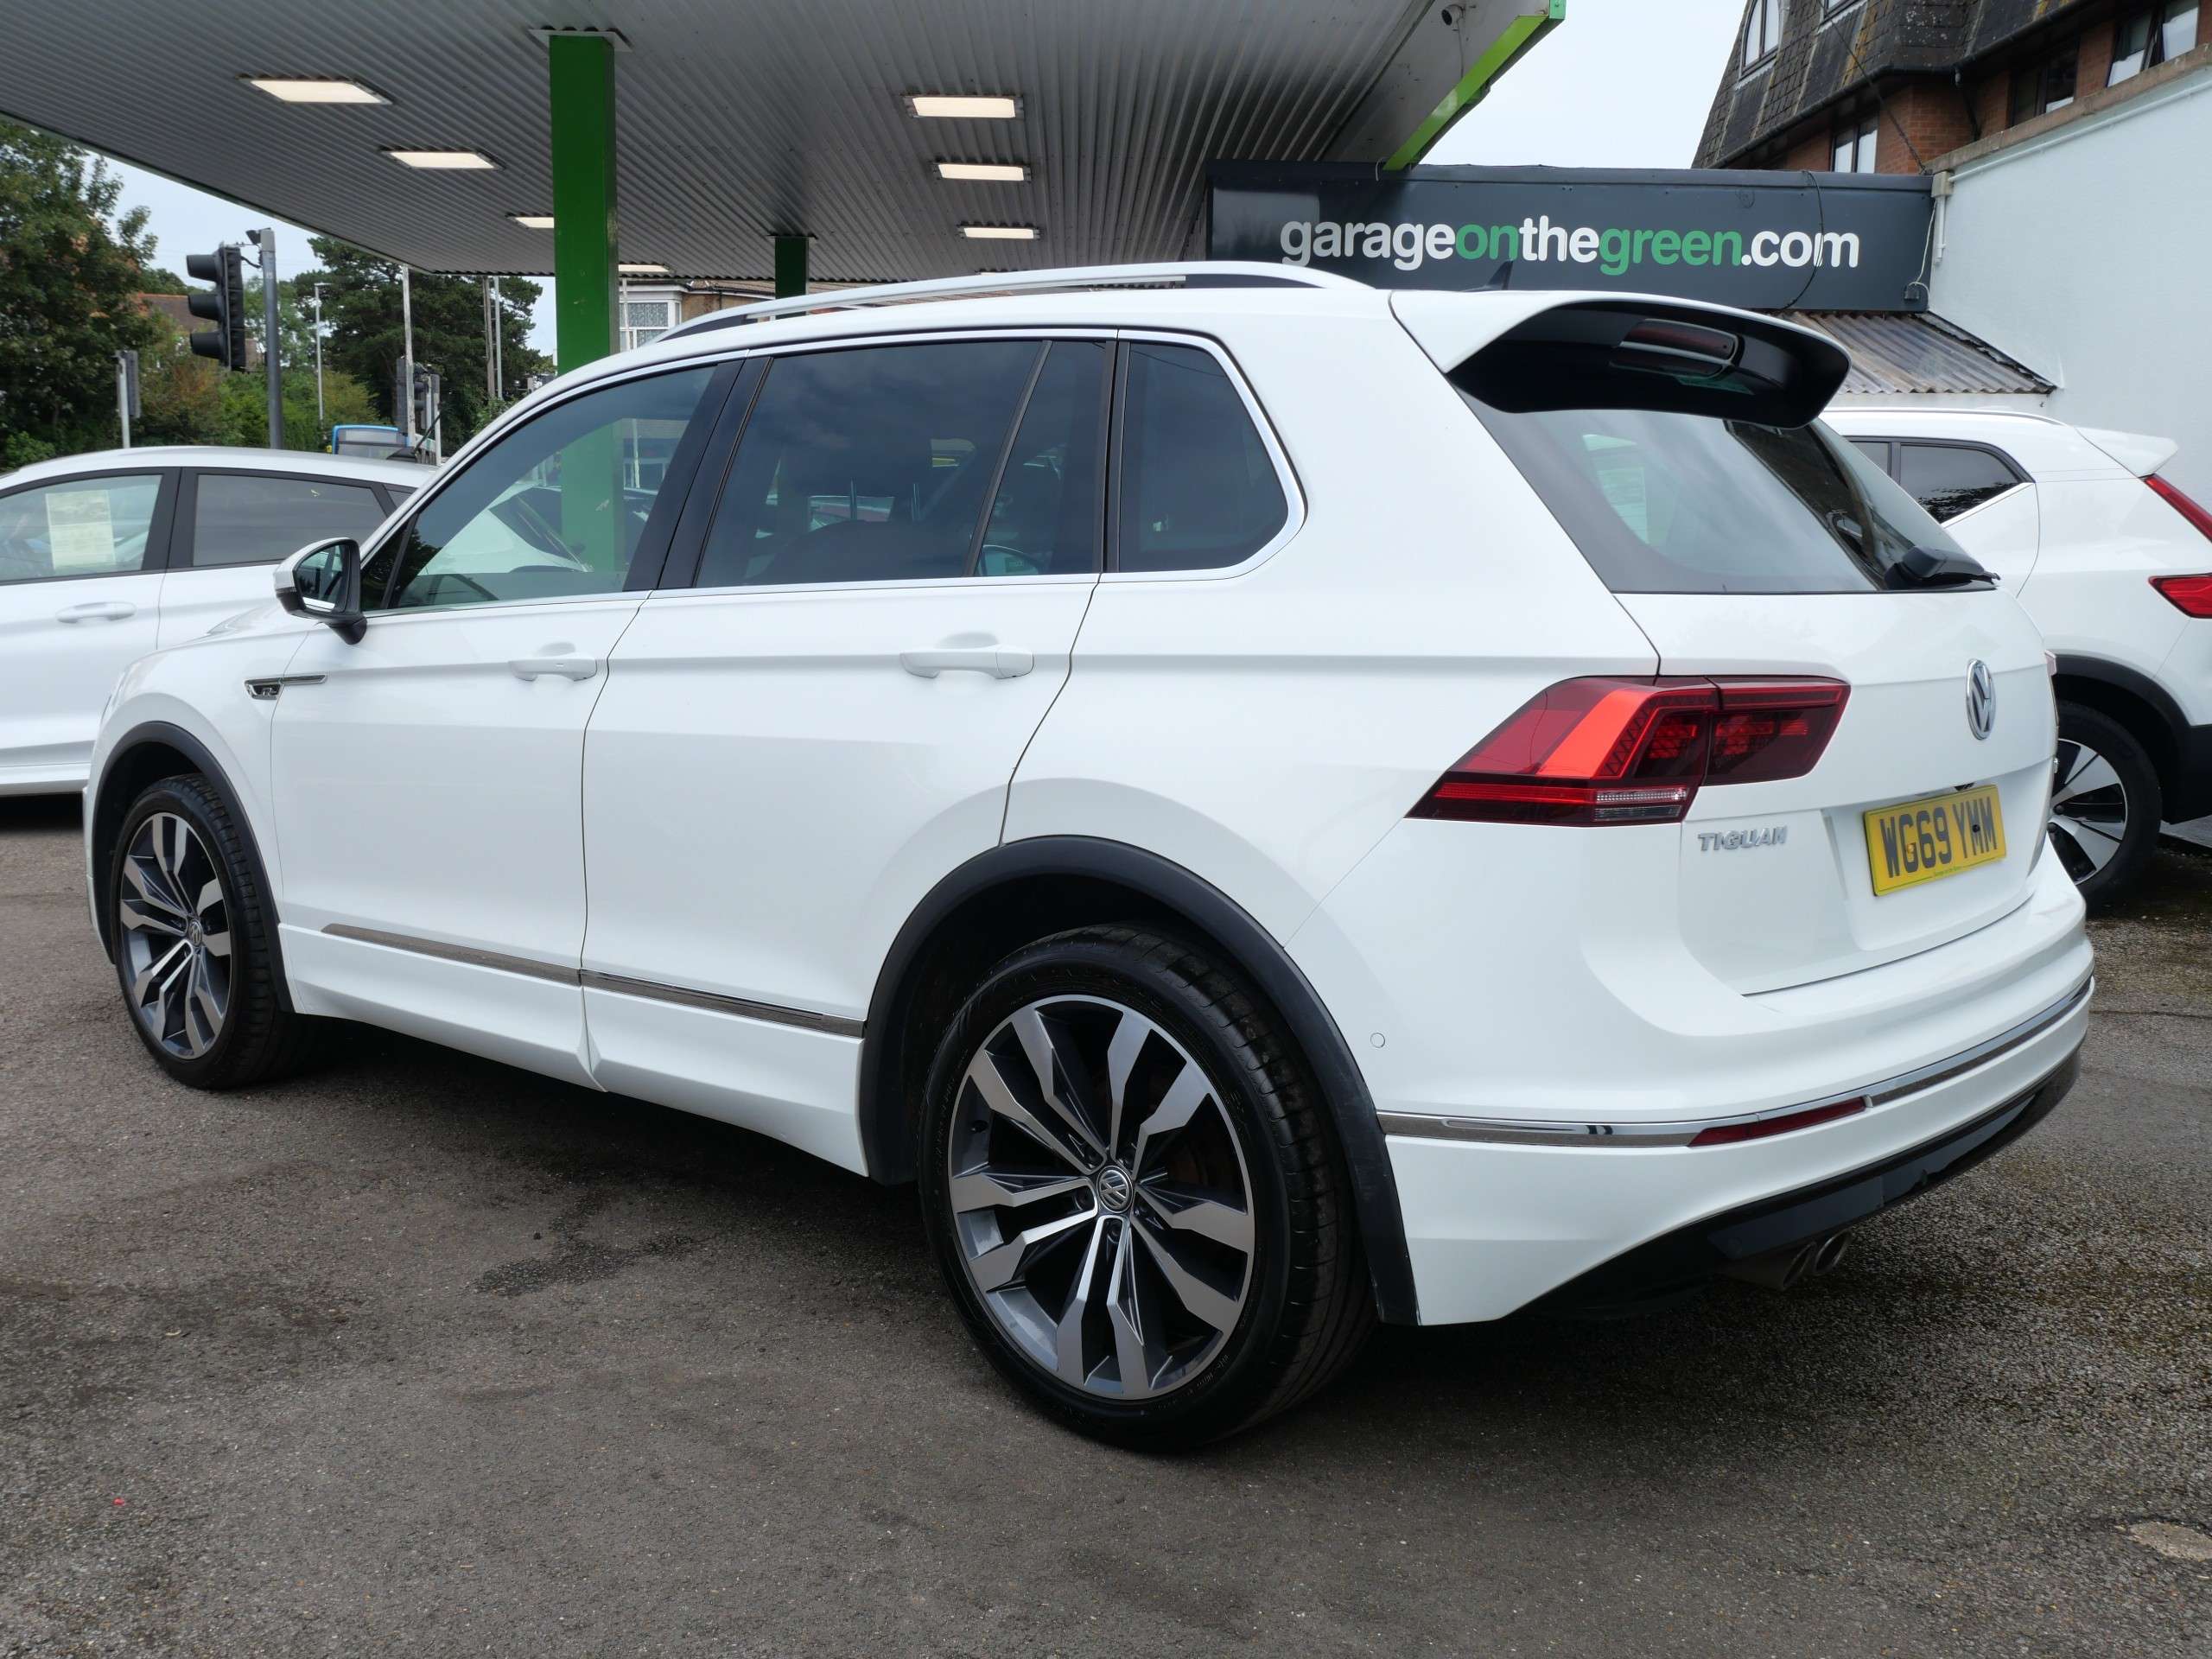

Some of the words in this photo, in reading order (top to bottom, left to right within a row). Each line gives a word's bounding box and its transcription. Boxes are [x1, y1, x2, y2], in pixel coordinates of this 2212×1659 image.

[1281, 215, 1859, 276] garageonthegreen.com
[1698, 826, 1788, 851] TIGUAN
[1879, 806, 1953, 879] WG69
[1952, 796, 1998, 859] YMM
